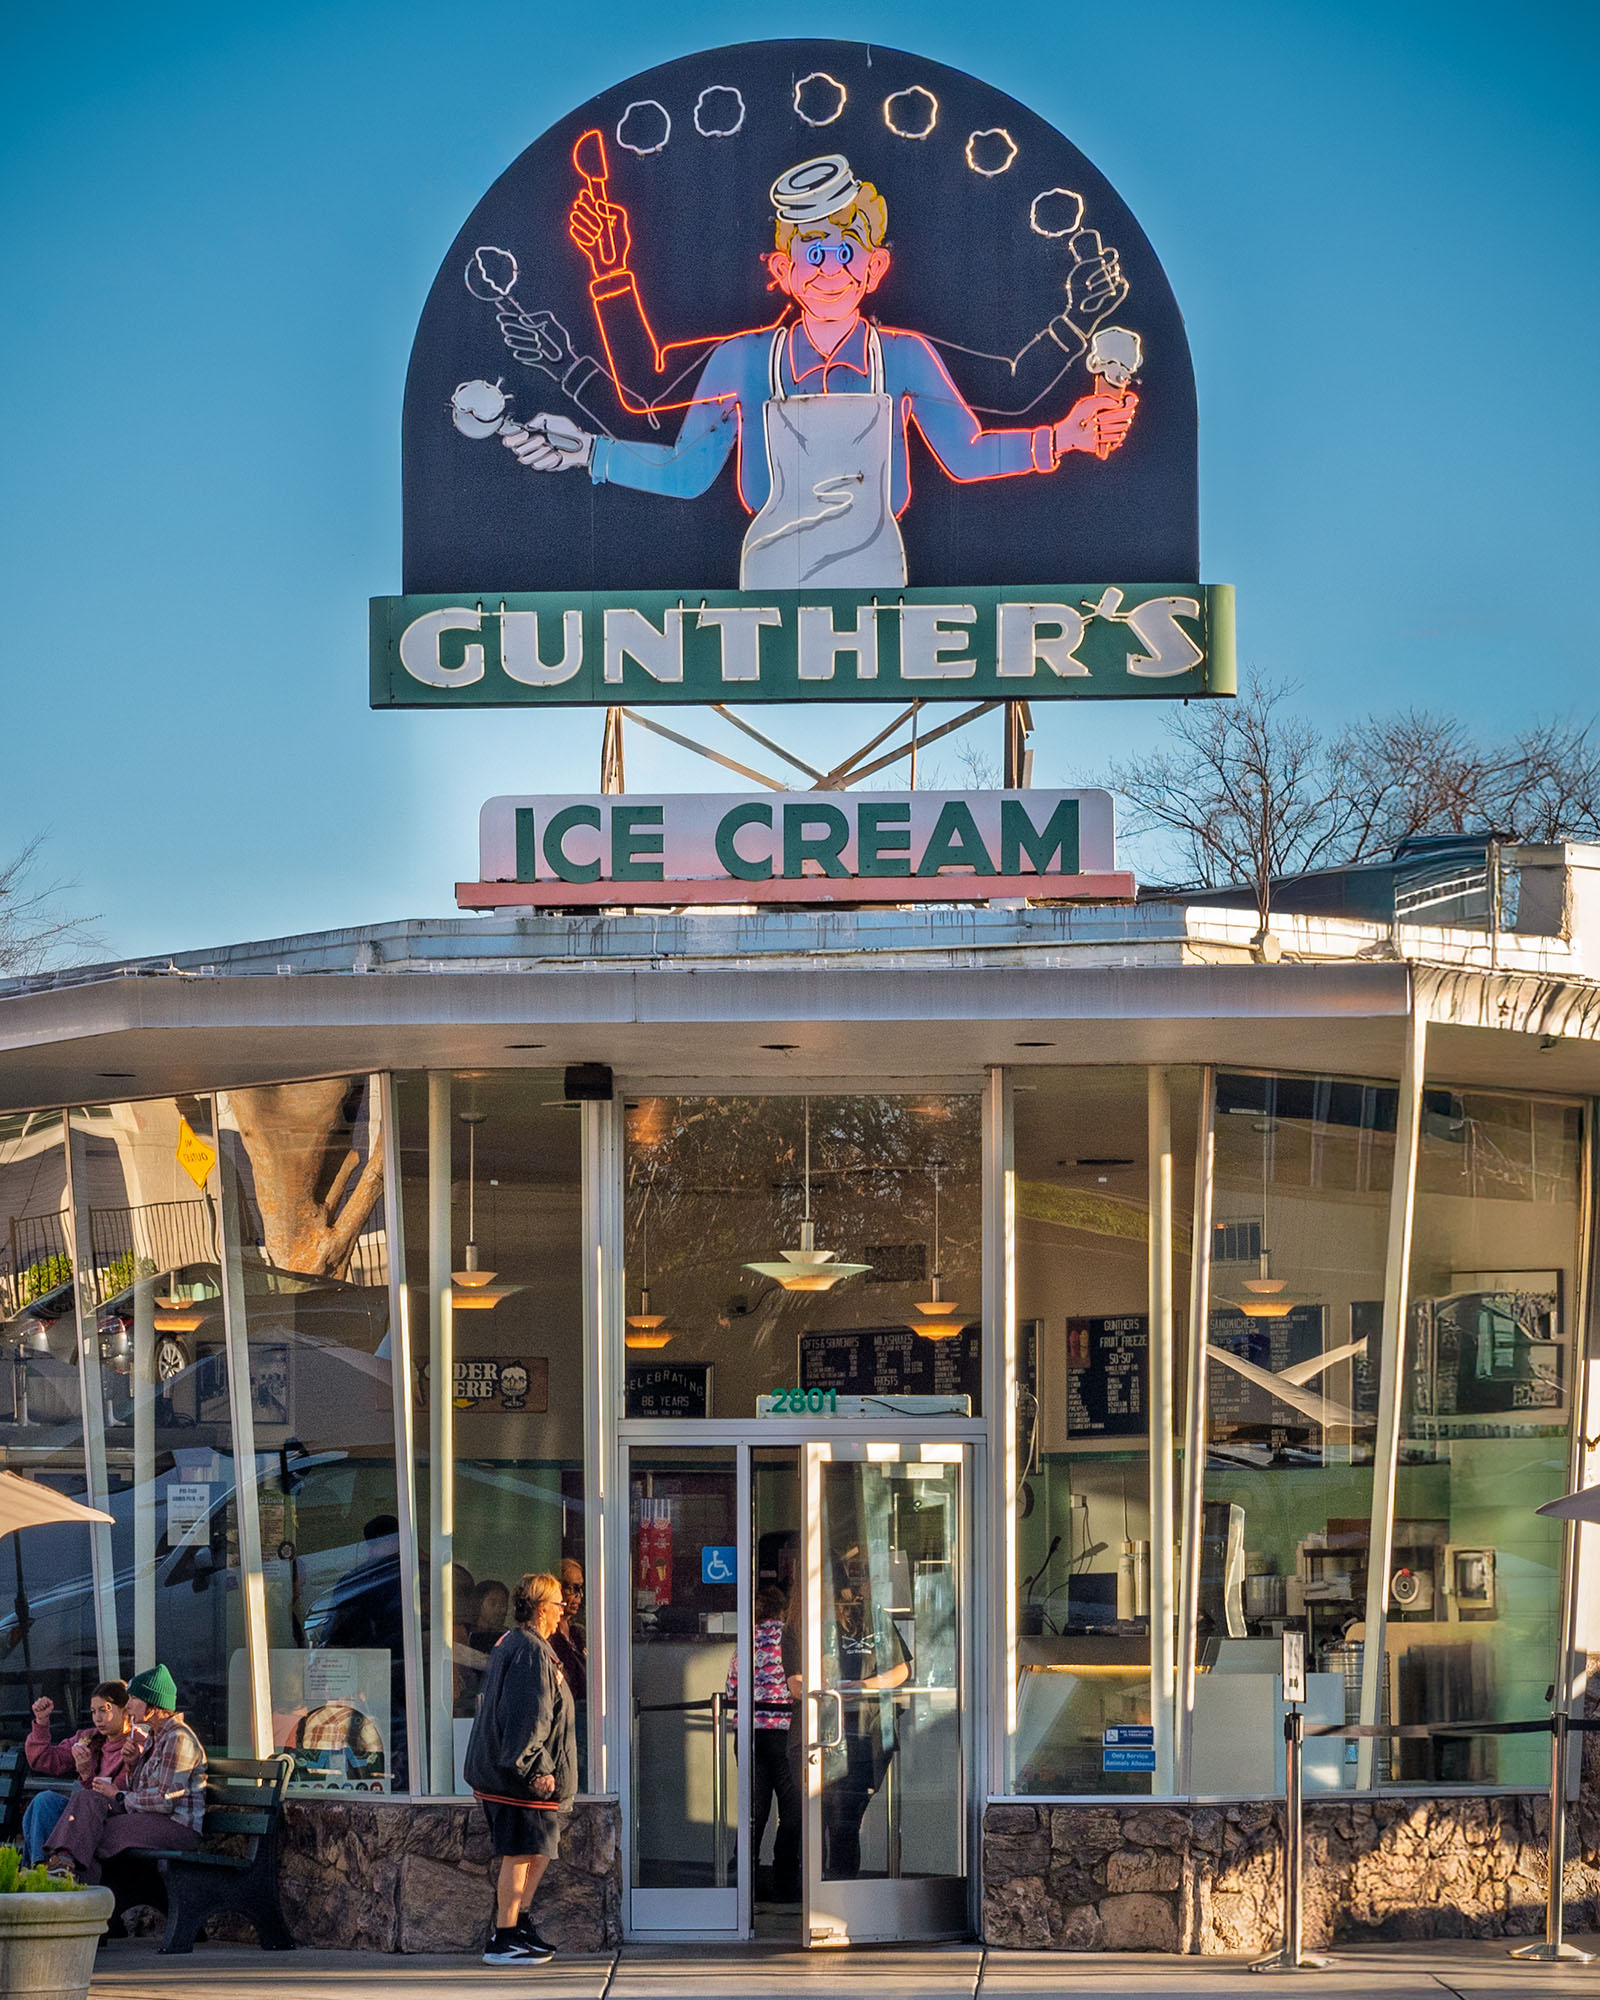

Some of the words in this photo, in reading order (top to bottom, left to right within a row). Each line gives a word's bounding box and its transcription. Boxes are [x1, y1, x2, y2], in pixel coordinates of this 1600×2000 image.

[400, 587, 1204, 688] GUNTHER'S
[515, 804, 664, 883] ICE
[715, 799, 1080, 882] CREAM
[1100, 1336, 1120, 1348] FRUIT
[1121, 1334, 1148, 1347] FREEZE
[453, 1381, 493, 1398] ERE
[626, 1369, 704, 1397] ELEBRATING
[641, 1395, 654, 1407] 86
[660, 1395, 689, 1407] YEARS
[771, 1387, 836, 1413] 2801
[1112, 1752, 1125, 1760] Only
[1126, 1752, 1149, 1760] Service
